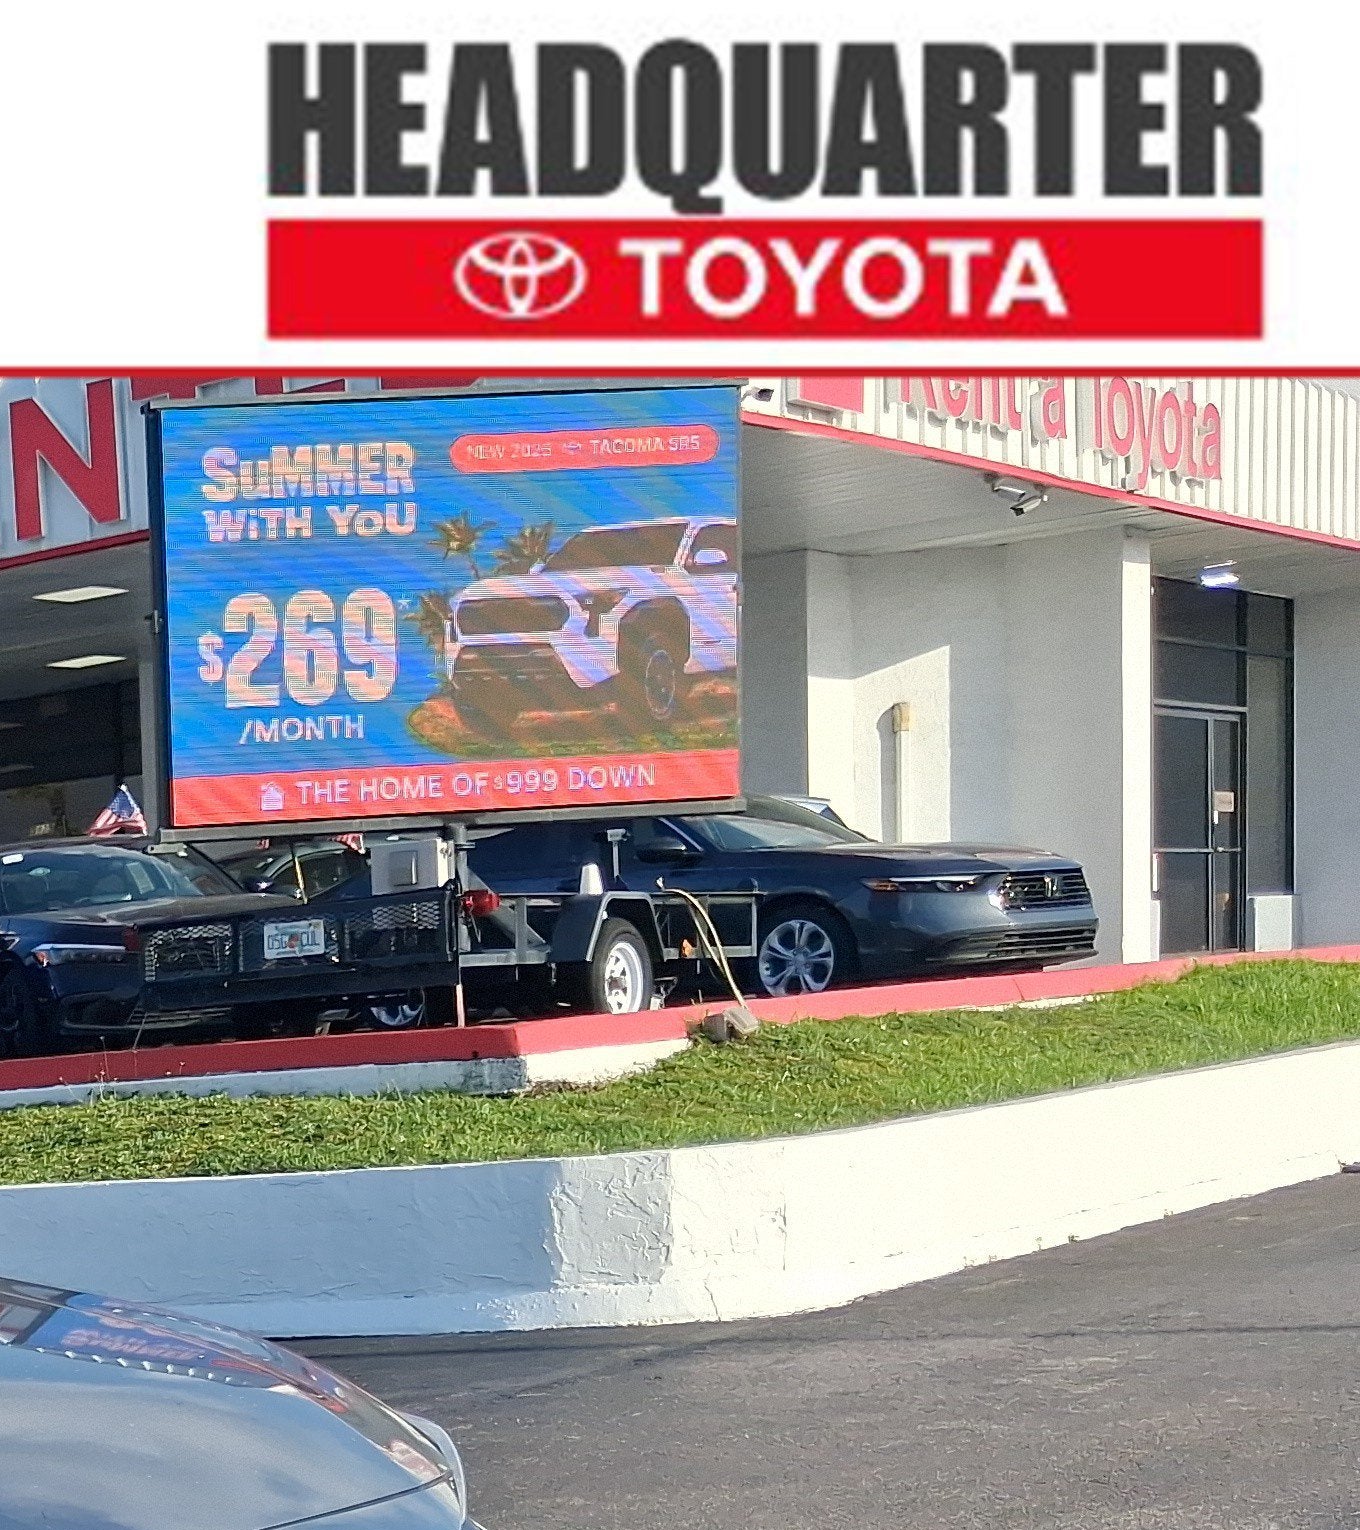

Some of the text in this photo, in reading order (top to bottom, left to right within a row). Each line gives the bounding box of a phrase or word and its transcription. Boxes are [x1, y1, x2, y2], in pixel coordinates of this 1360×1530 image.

[901, 377, 1022, 431] ent
[589, 436, 665, 455] TACOMA
[197, 588, 399, 709] $269
[239, 715, 365, 746] /MONTH
[296, 779, 350, 804] THE
[358, 775, 442, 802] HOME
[451, 772, 489, 796] OF
[567, 763, 656, 790] DOWN
